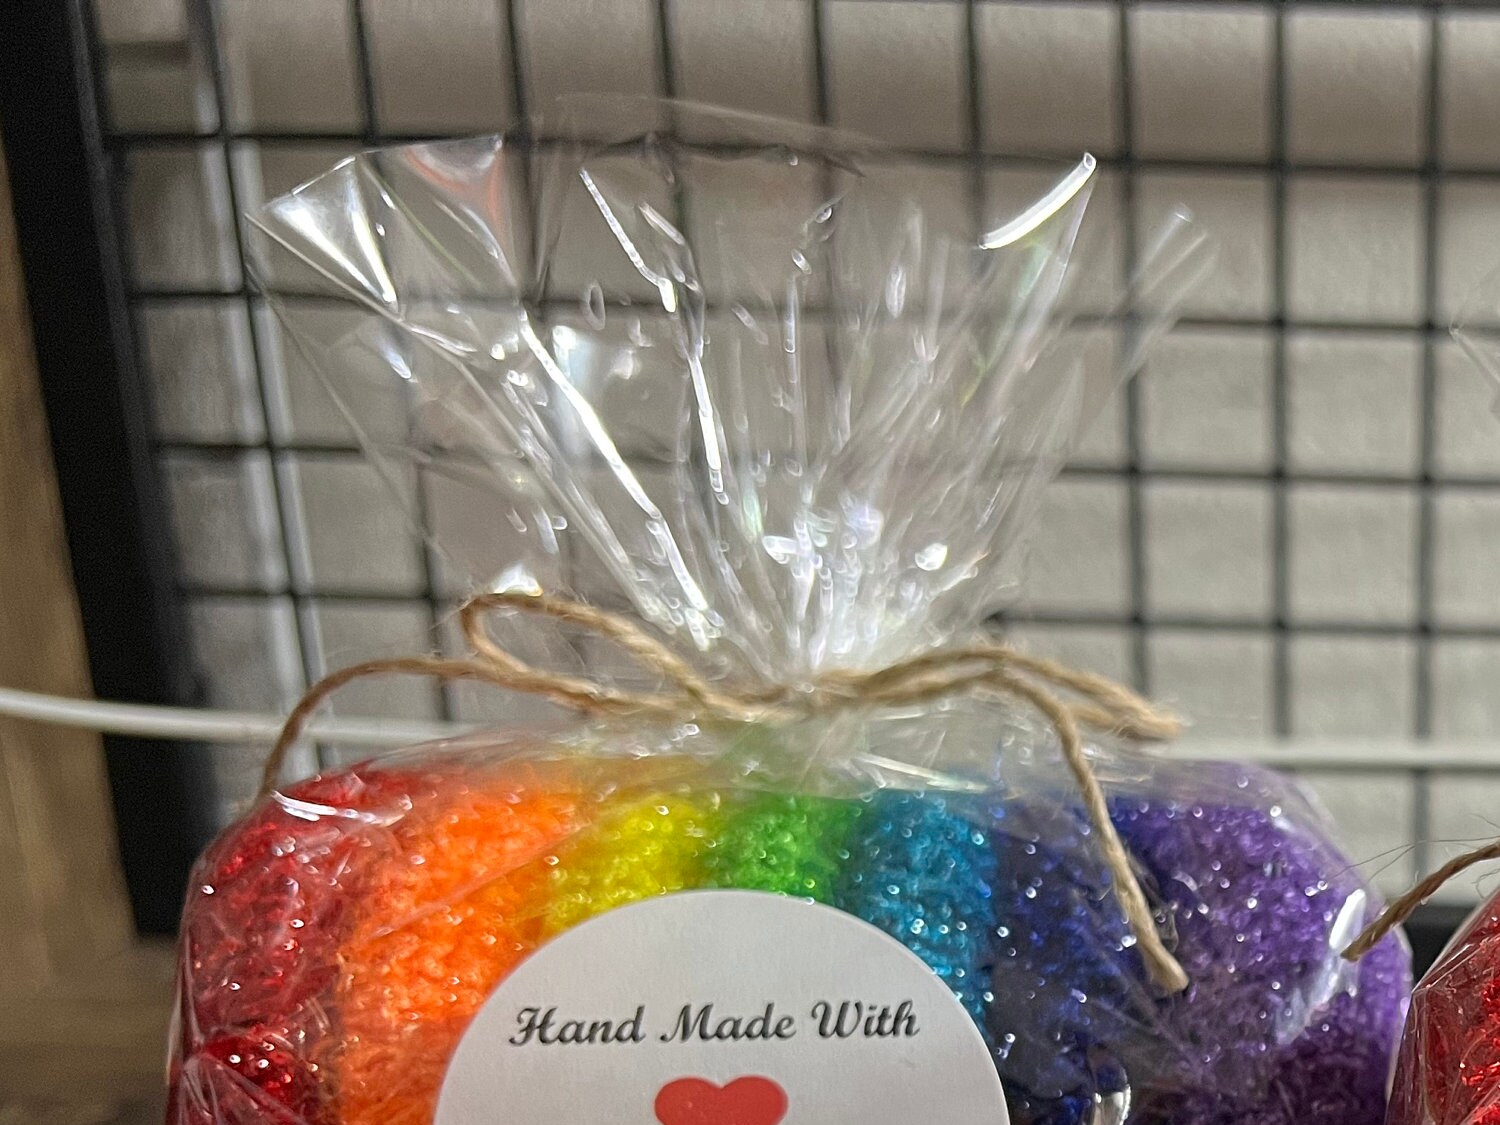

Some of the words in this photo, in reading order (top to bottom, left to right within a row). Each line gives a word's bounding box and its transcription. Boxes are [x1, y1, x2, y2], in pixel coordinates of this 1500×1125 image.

[508, 1004, 647, 1047] Hand
[658, 1002, 797, 1044] Made
[810, 999, 921, 1040] With
